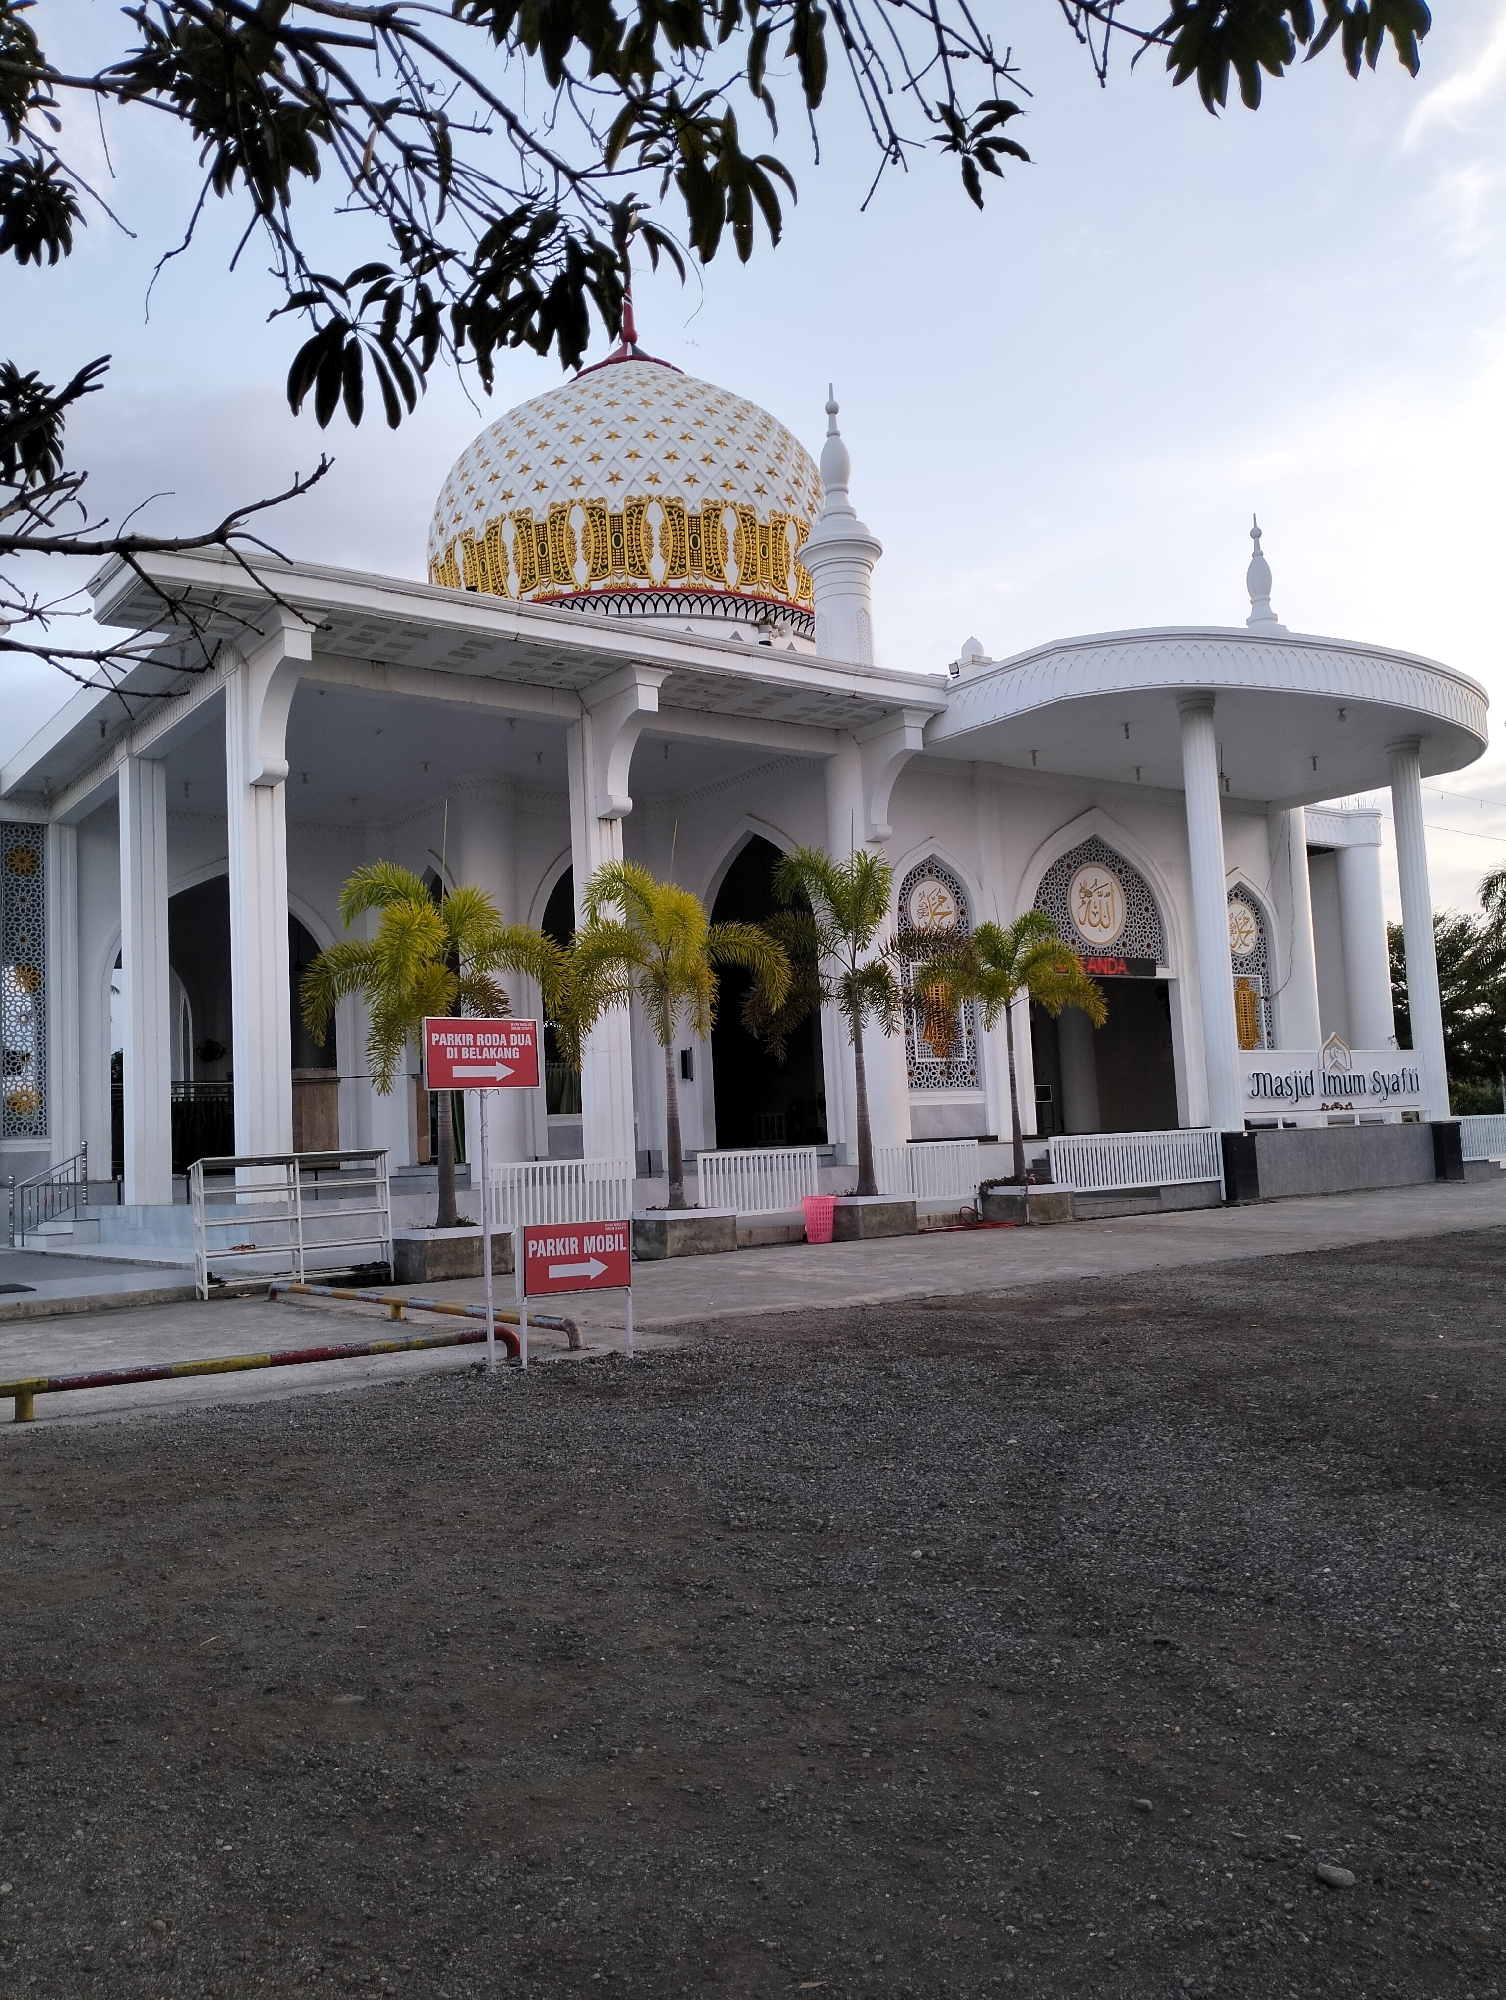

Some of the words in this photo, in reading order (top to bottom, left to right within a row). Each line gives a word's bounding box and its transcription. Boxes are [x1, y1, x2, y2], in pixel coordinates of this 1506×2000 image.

[431, 1032, 474, 1046] PARKIR
[476, 1033, 507, 1046] RODA
[509, 1033, 532, 1046] DUA
[446, 1047, 458, 1059] DI
[461, 1047, 520, 1059] BELAKANG
[1249, 1069, 1316, 1103] Masjid
[528, 1236, 579, 1258] PARKIR
[583, 1233, 627, 1254] MOBIL
